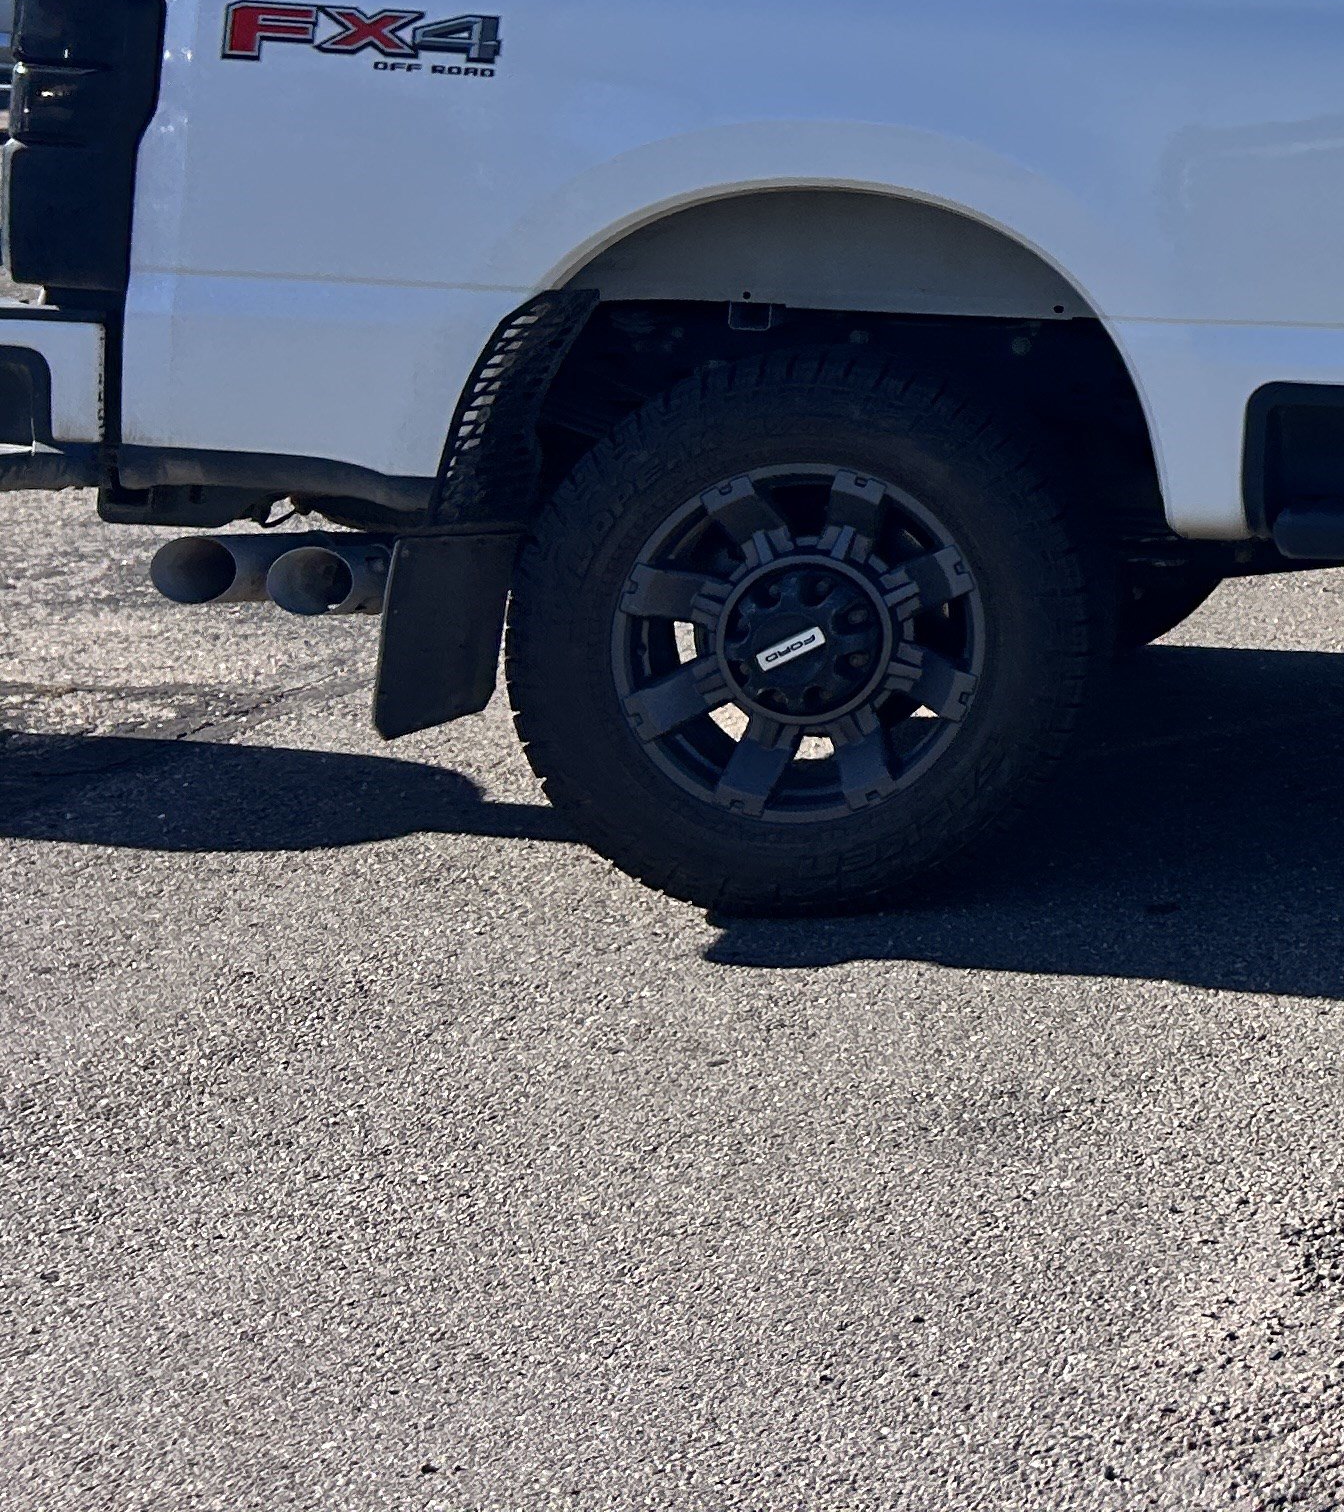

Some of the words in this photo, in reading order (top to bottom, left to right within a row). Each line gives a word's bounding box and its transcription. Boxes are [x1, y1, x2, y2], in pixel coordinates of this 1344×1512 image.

[220, 0, 502, 64] FX4
[373, 61, 422, 73] OFF
[431, 65, 495, 78] ROAD
[765, 634, 816, 663] FORD
